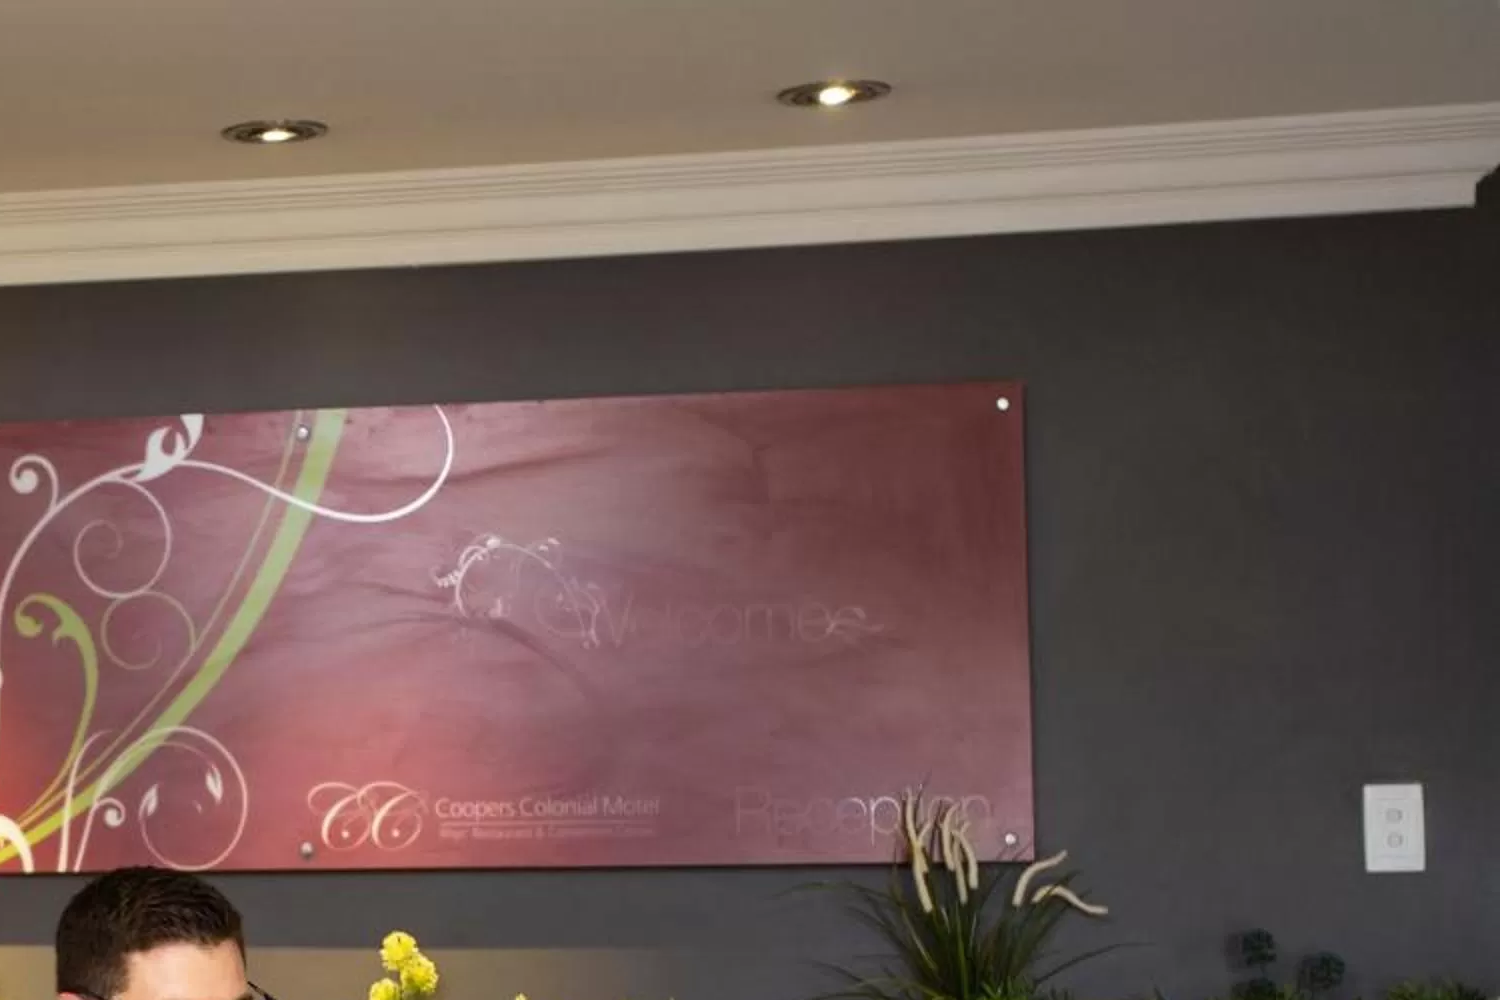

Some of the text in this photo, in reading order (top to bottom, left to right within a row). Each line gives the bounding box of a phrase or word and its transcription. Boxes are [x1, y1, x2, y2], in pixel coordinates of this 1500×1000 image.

[434, 793, 661, 822] Coopers Colonial Motel
